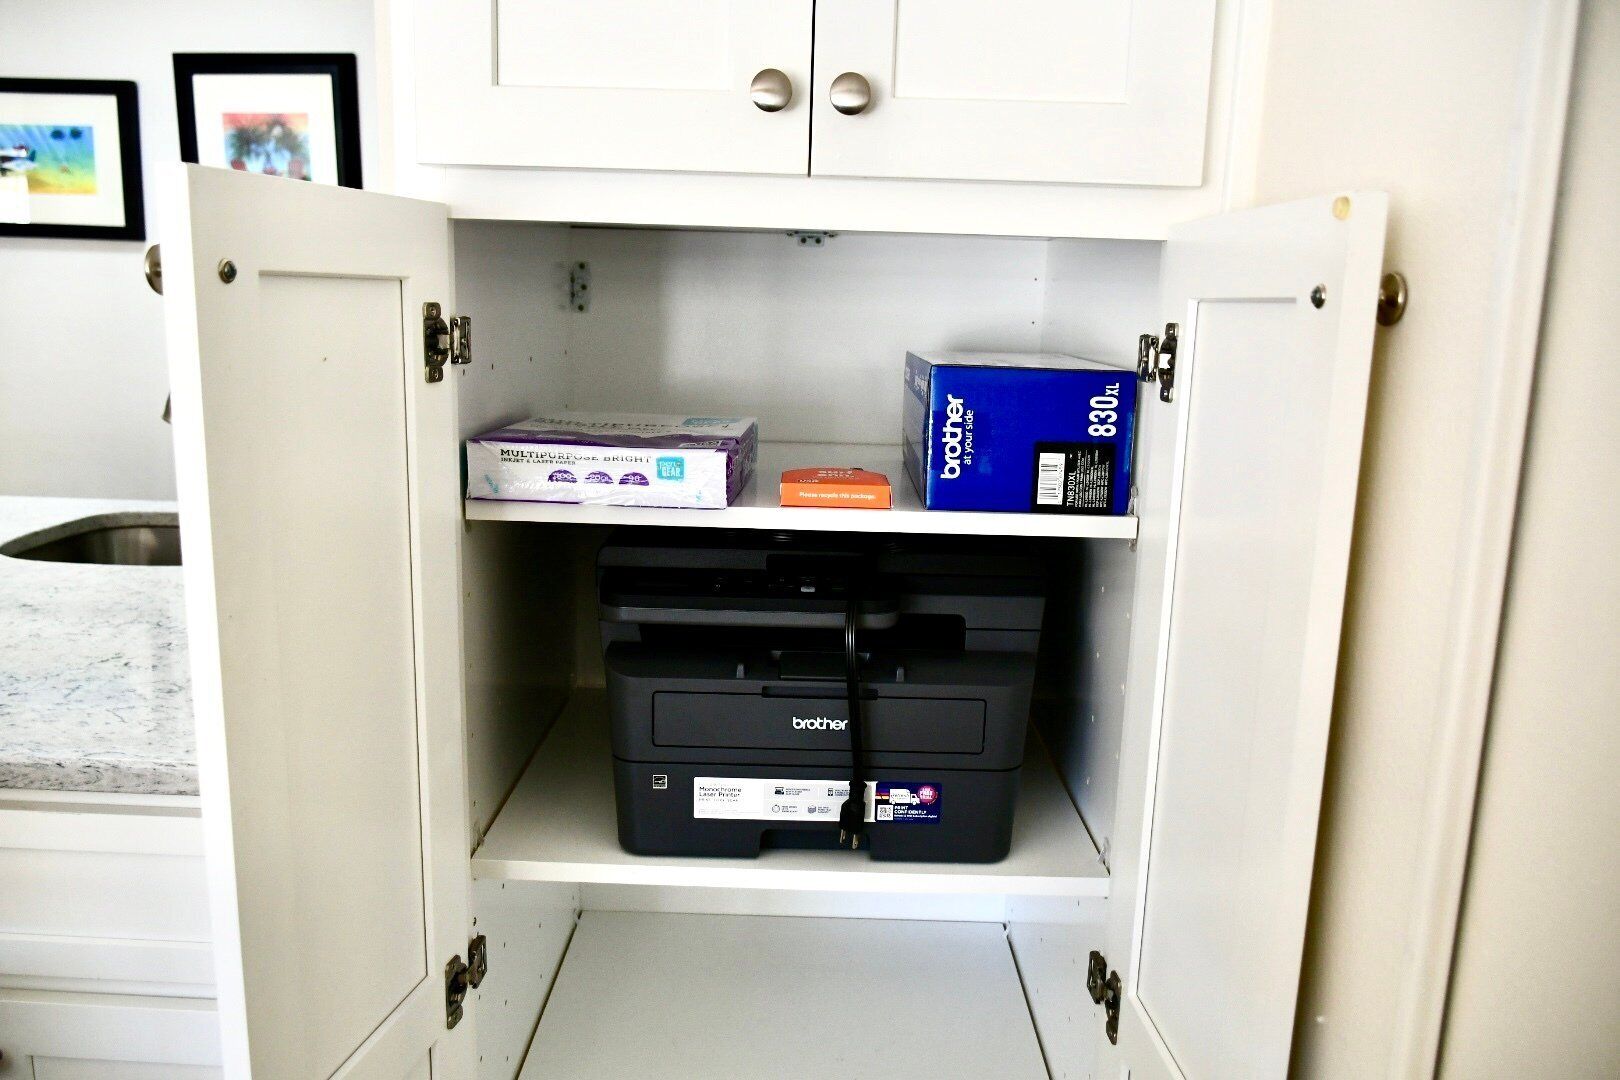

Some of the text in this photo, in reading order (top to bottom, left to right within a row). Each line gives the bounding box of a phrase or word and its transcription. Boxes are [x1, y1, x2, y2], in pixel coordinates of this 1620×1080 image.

[940, 393, 964, 479] brother
[963, 410, 974, 465] at your side
[500, 449, 598, 461] MULTIPURPOSE
[1067, 471, 1076, 506] TN830XL
[793, 716, 848, 730] brother
